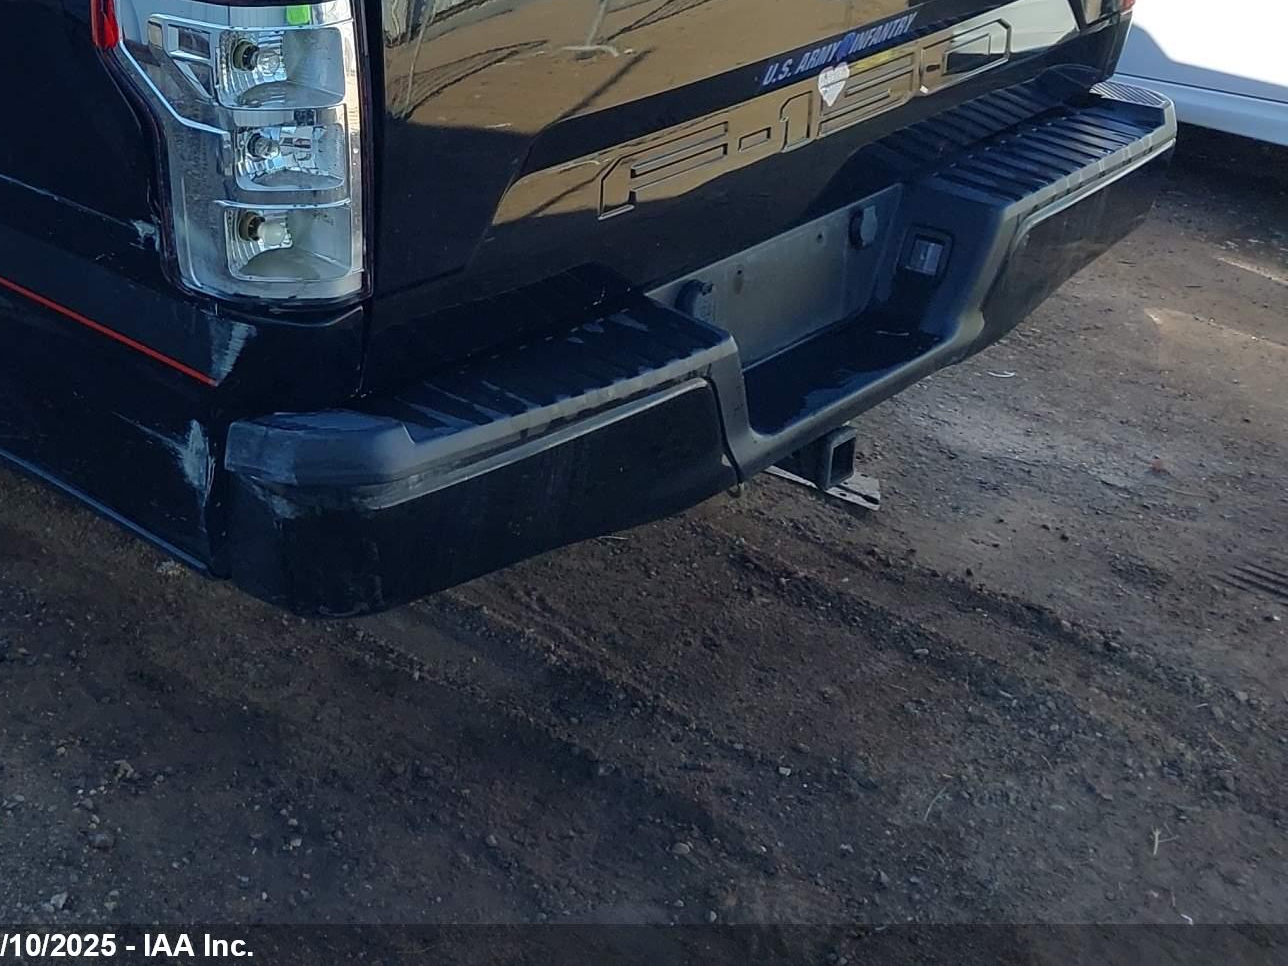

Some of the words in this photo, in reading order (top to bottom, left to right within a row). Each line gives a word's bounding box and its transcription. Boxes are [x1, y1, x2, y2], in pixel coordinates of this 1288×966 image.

[762, 58, 793, 86] U.S.
[795, 40, 841, 74] ARMY
[848, 12, 917, 54] INFANTRY
